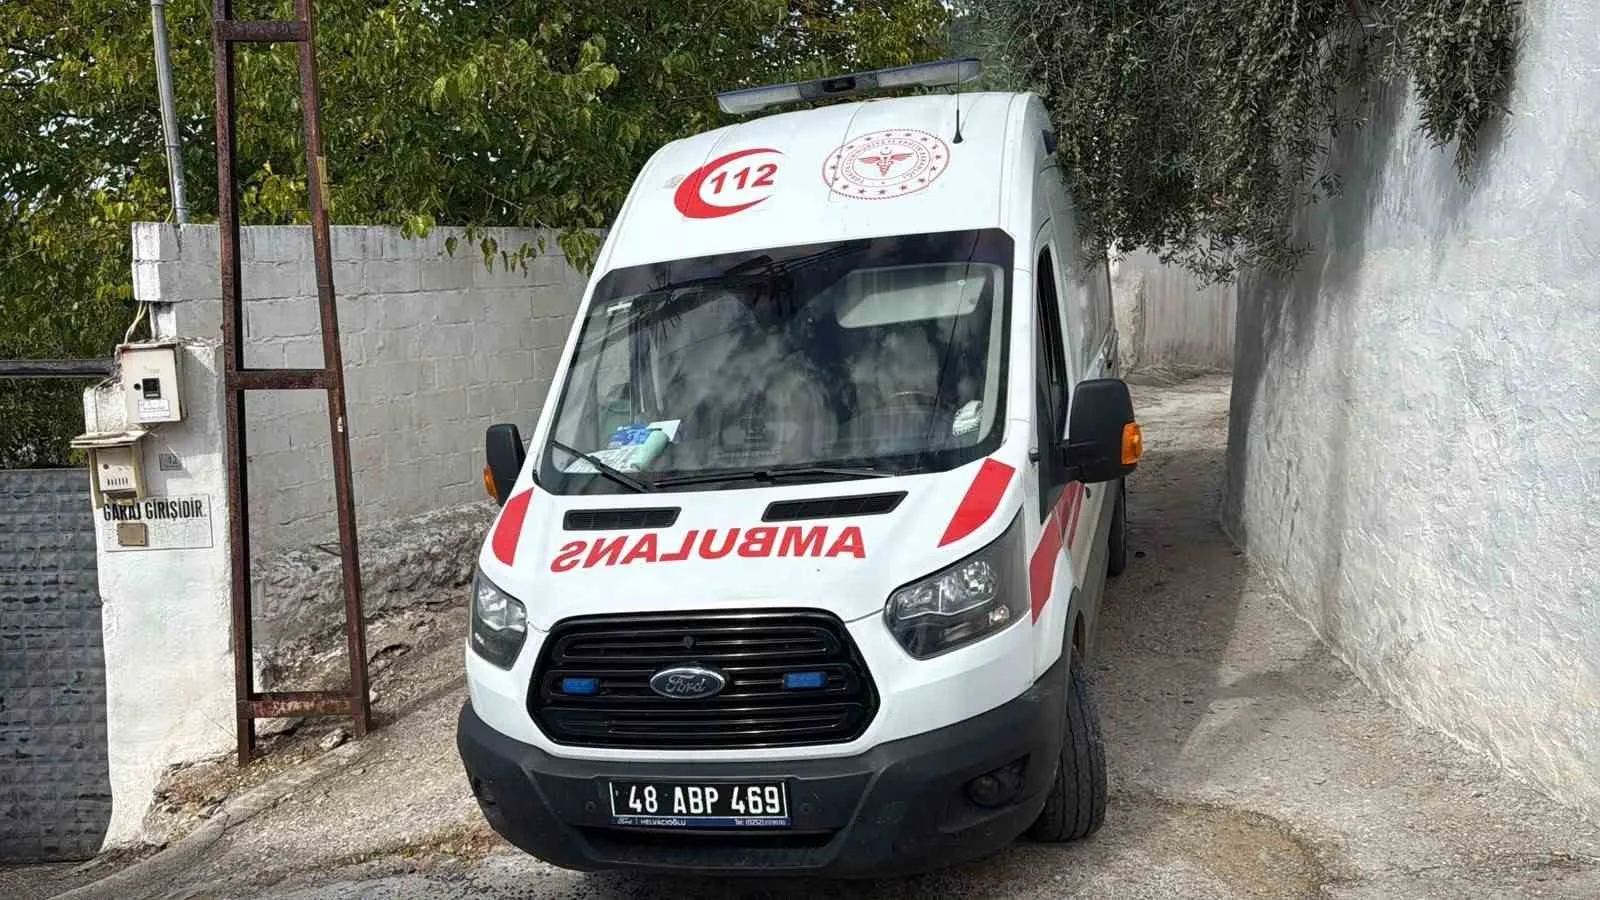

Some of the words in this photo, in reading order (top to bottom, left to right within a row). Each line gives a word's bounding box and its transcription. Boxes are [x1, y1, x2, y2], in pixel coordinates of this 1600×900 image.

[709, 163, 778, 195] 112
[103, 502, 141, 521] GARAJ
[665, 675, 705, 693] Ford
[628, 785, 658, 814] 48
[673, 786, 719, 815] ABP
[731, 786, 780, 815] 469
